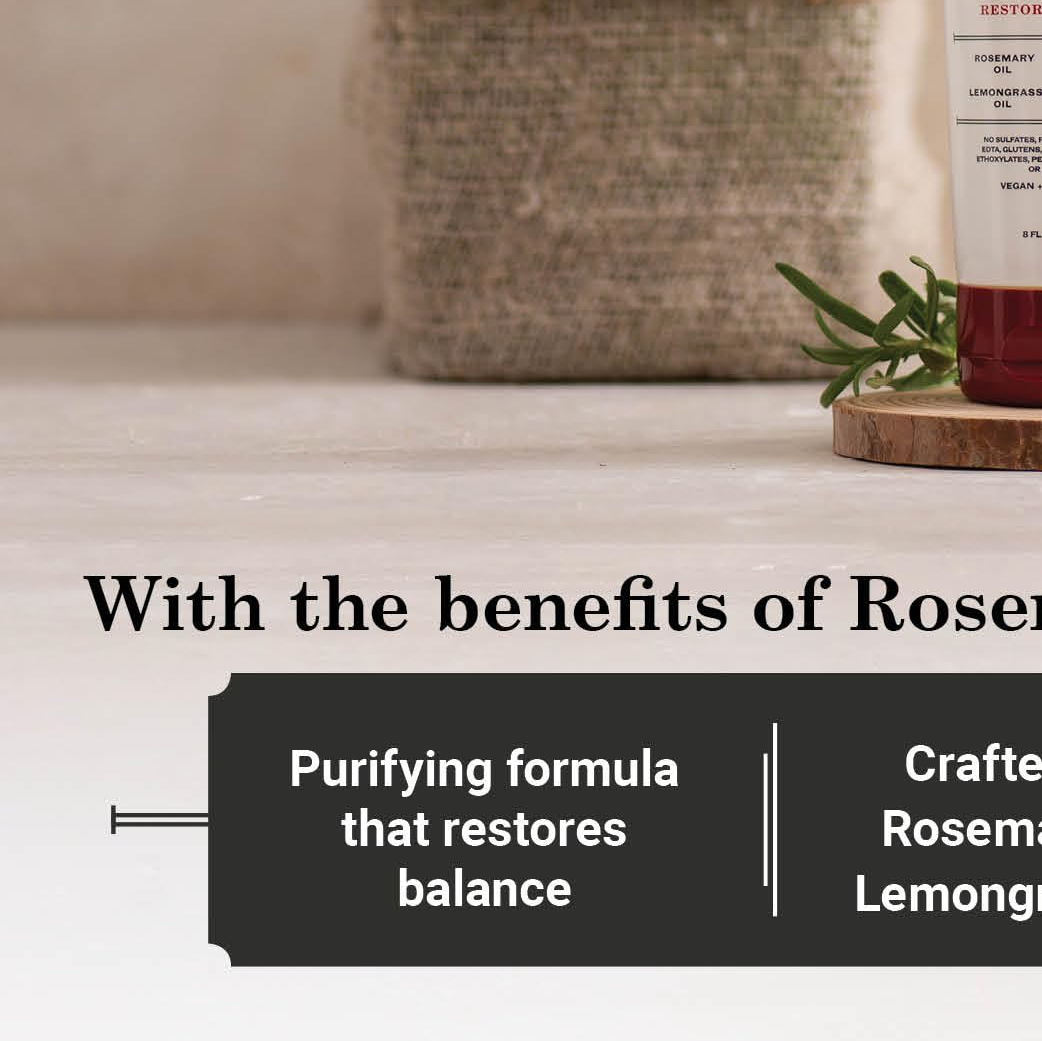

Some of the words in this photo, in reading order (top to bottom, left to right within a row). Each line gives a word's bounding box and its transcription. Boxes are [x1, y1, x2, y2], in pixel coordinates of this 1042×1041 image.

[974, 54, 1036, 63] ROSEMARY
[993, 65, 1013, 75] OIL
[993, 100, 1013, 109] OIL
[995, 136, 1037, 144] SULFATES,
[1002, 146, 1042, 154] GLUTENS,
[1000, 182, 1034, 190] VEGAN
